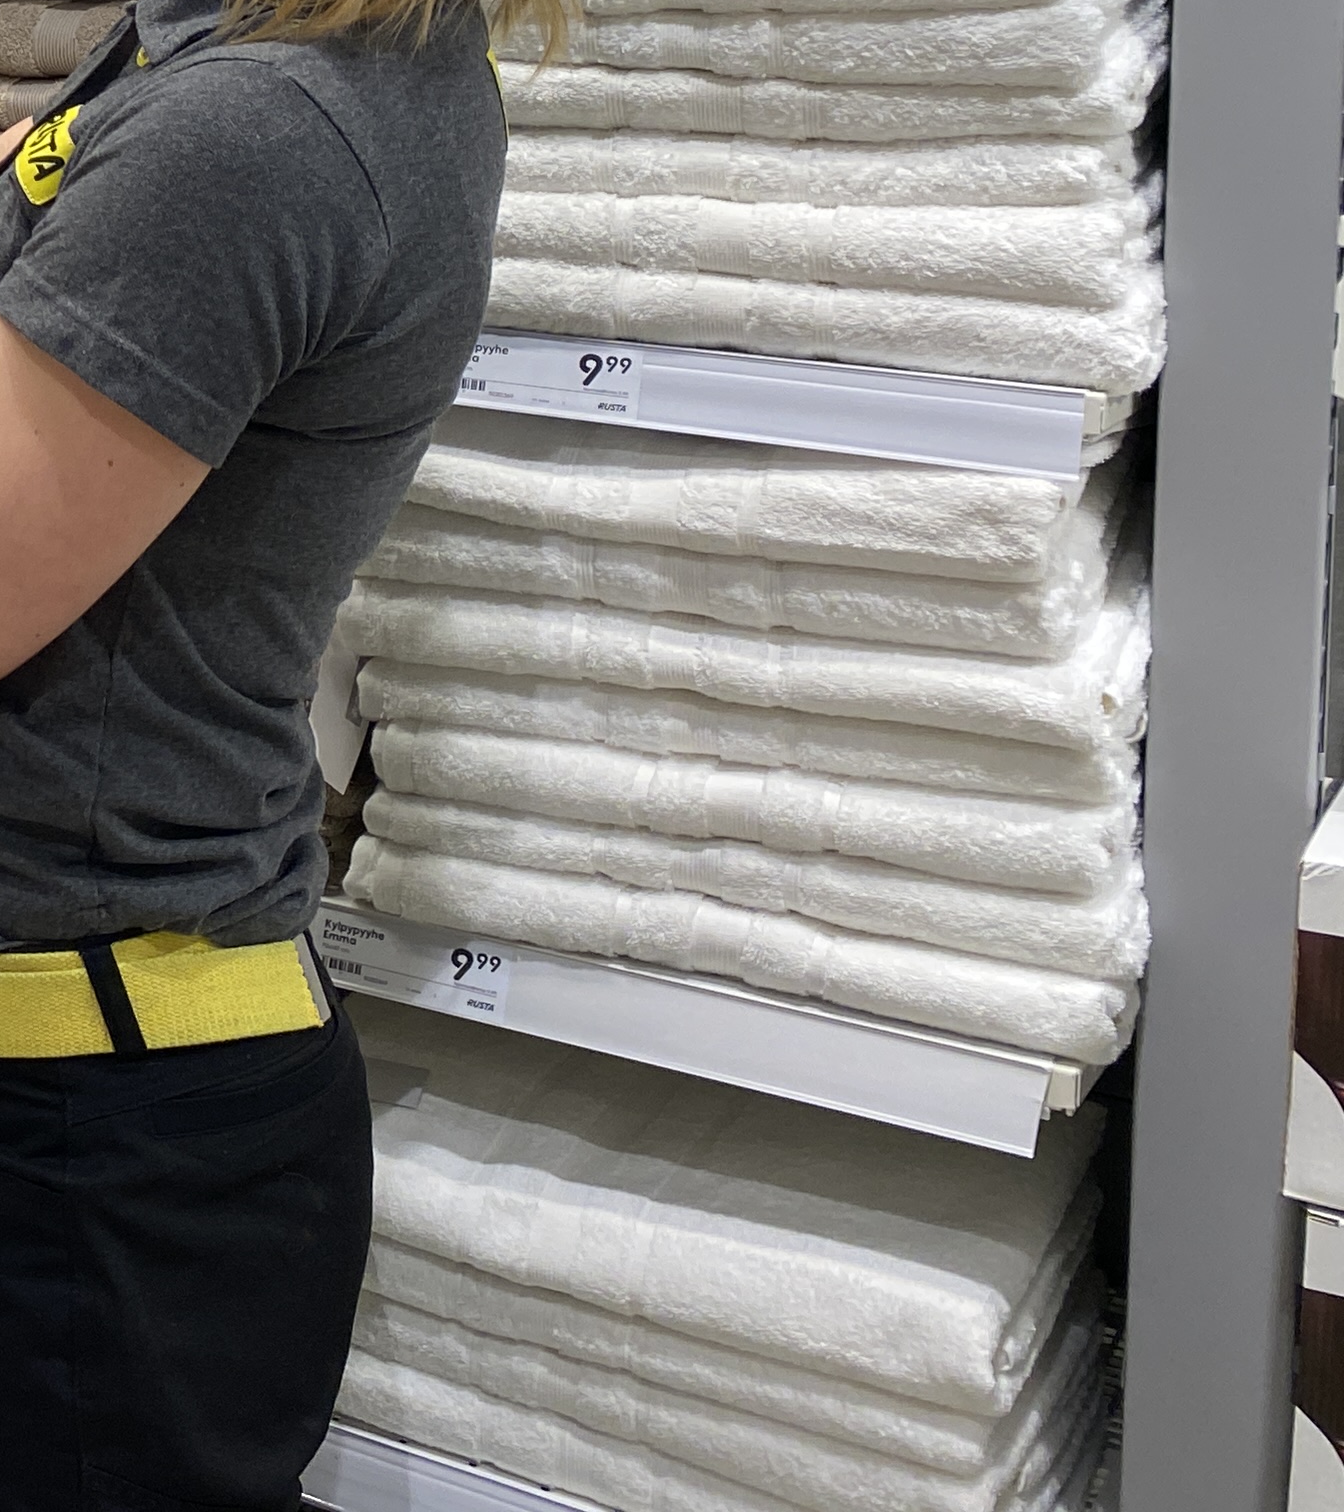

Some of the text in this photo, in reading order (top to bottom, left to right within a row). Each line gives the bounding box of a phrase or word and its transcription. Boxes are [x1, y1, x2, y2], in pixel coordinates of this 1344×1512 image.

[598, 402, 627, 413] RUSTA
[325, 919, 385, 941] Kylpypyyhe
[323, 930, 357, 946] Emma
[467, 998, 495, 1012] RUSTA
